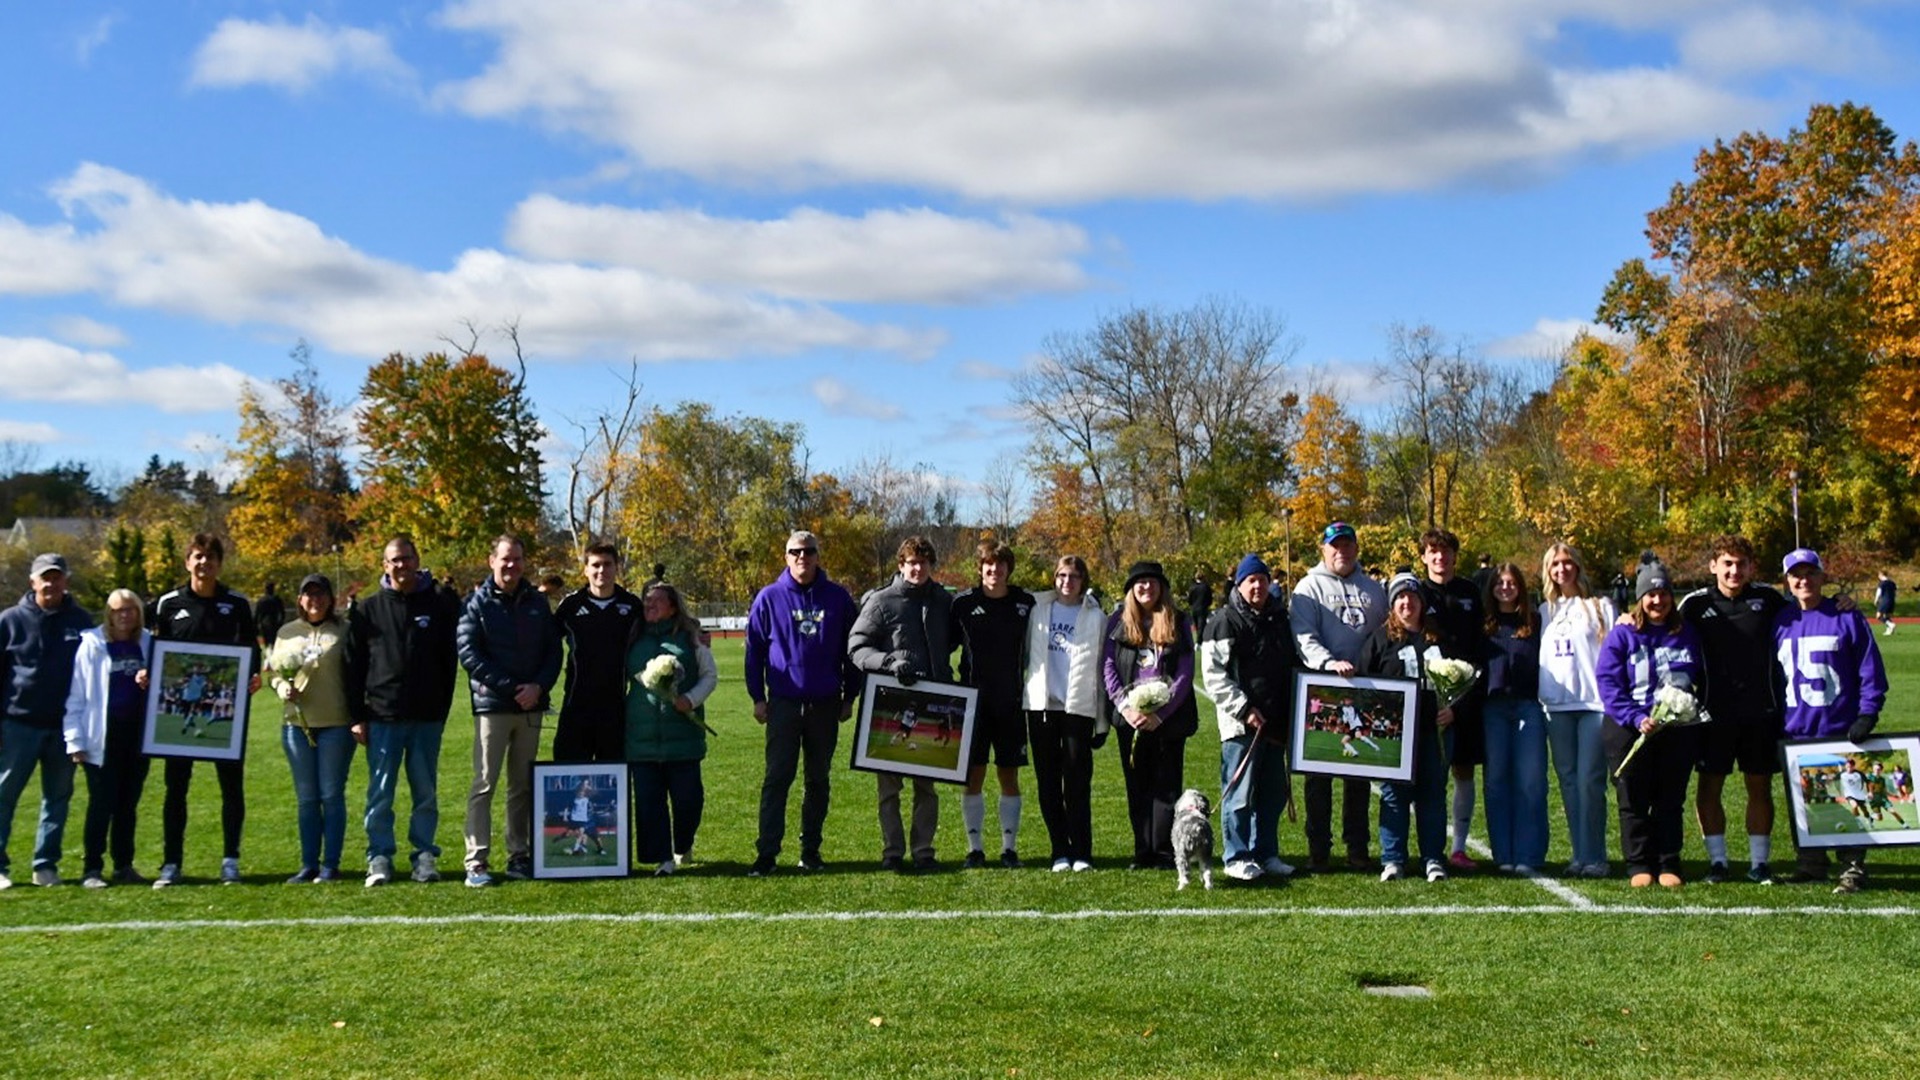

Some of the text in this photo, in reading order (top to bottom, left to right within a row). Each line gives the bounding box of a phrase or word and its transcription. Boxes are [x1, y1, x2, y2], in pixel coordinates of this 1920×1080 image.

[1049, 622, 1075, 634] ZARE
[1553, 639, 1574, 657] 11
[1777, 635, 1840, 707] 15
